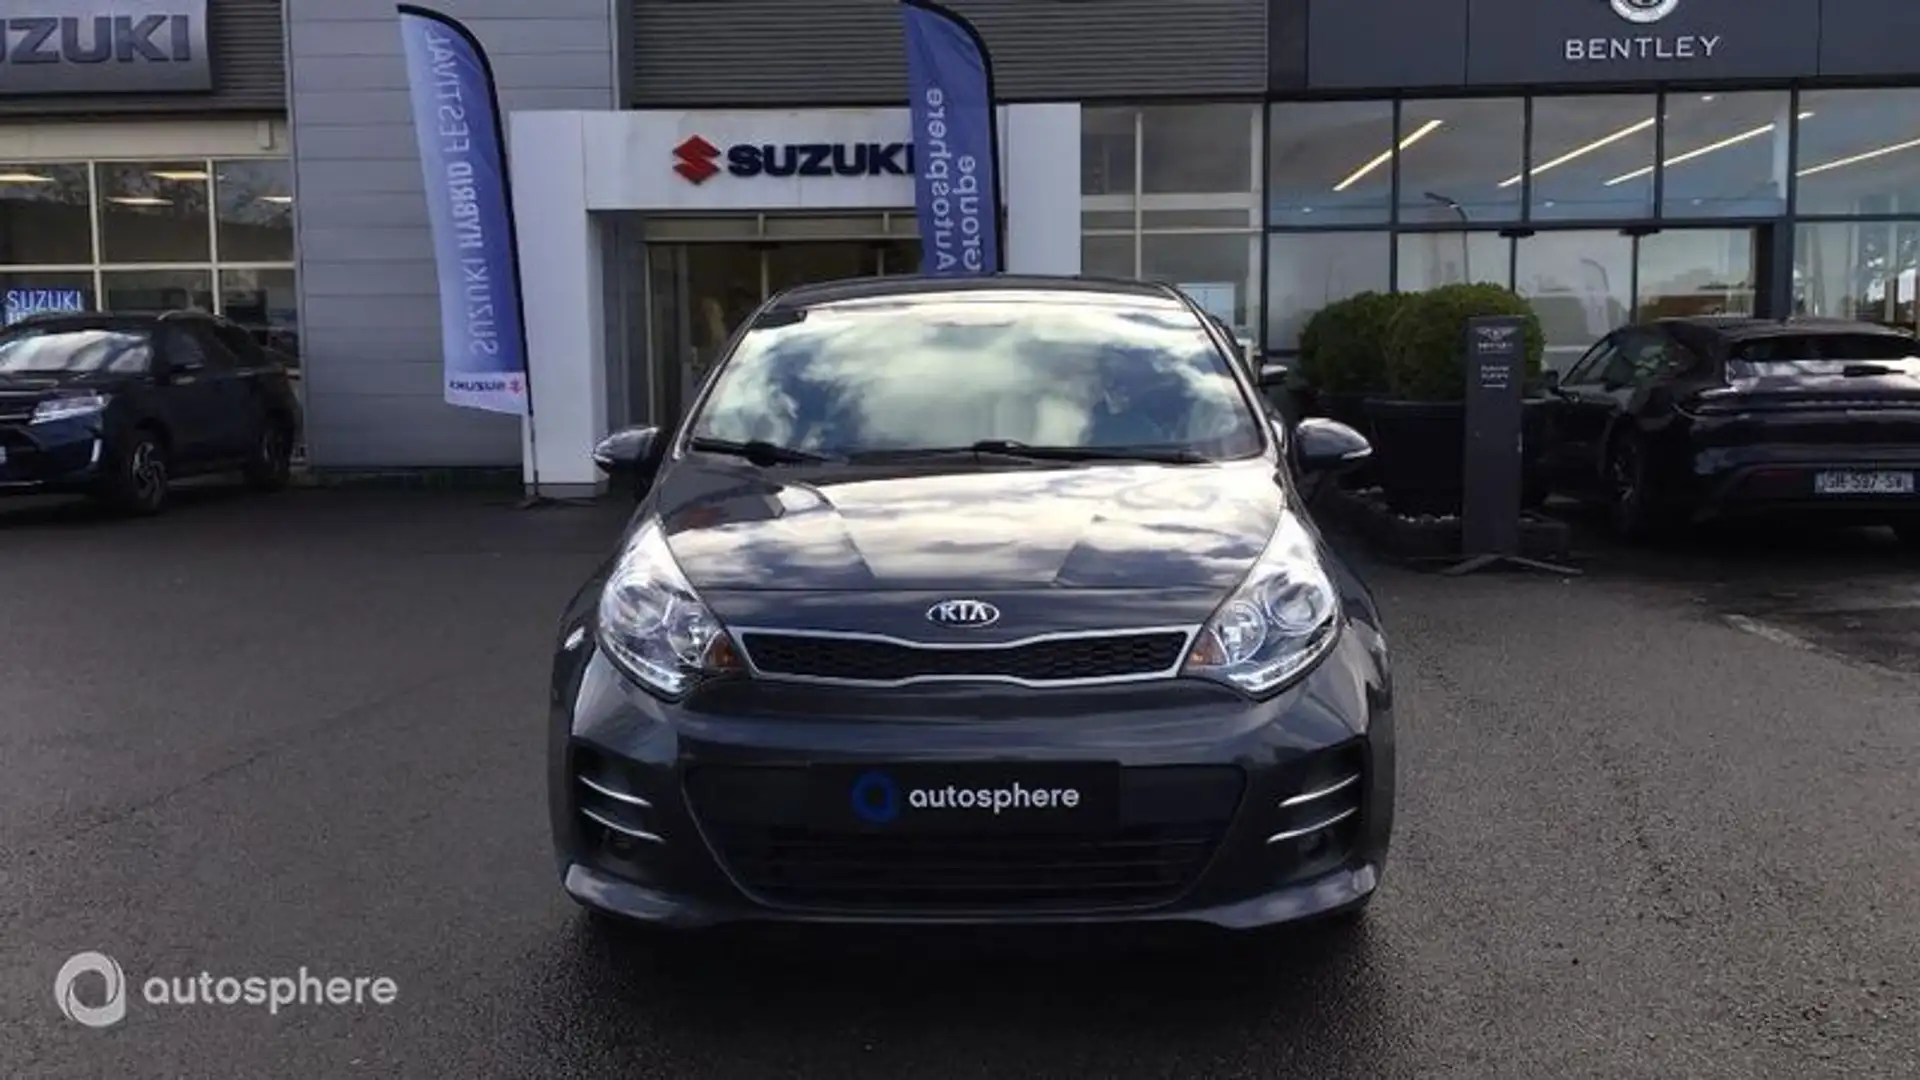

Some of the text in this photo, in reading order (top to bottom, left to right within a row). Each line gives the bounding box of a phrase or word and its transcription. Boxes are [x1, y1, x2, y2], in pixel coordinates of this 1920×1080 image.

[0, 15, 191, 64] ZUKI
[1564, 35, 1721, 60] BENTLEY
[5, 289, 84, 312] SUZUKI
[938, 601, 989, 622] KIA
